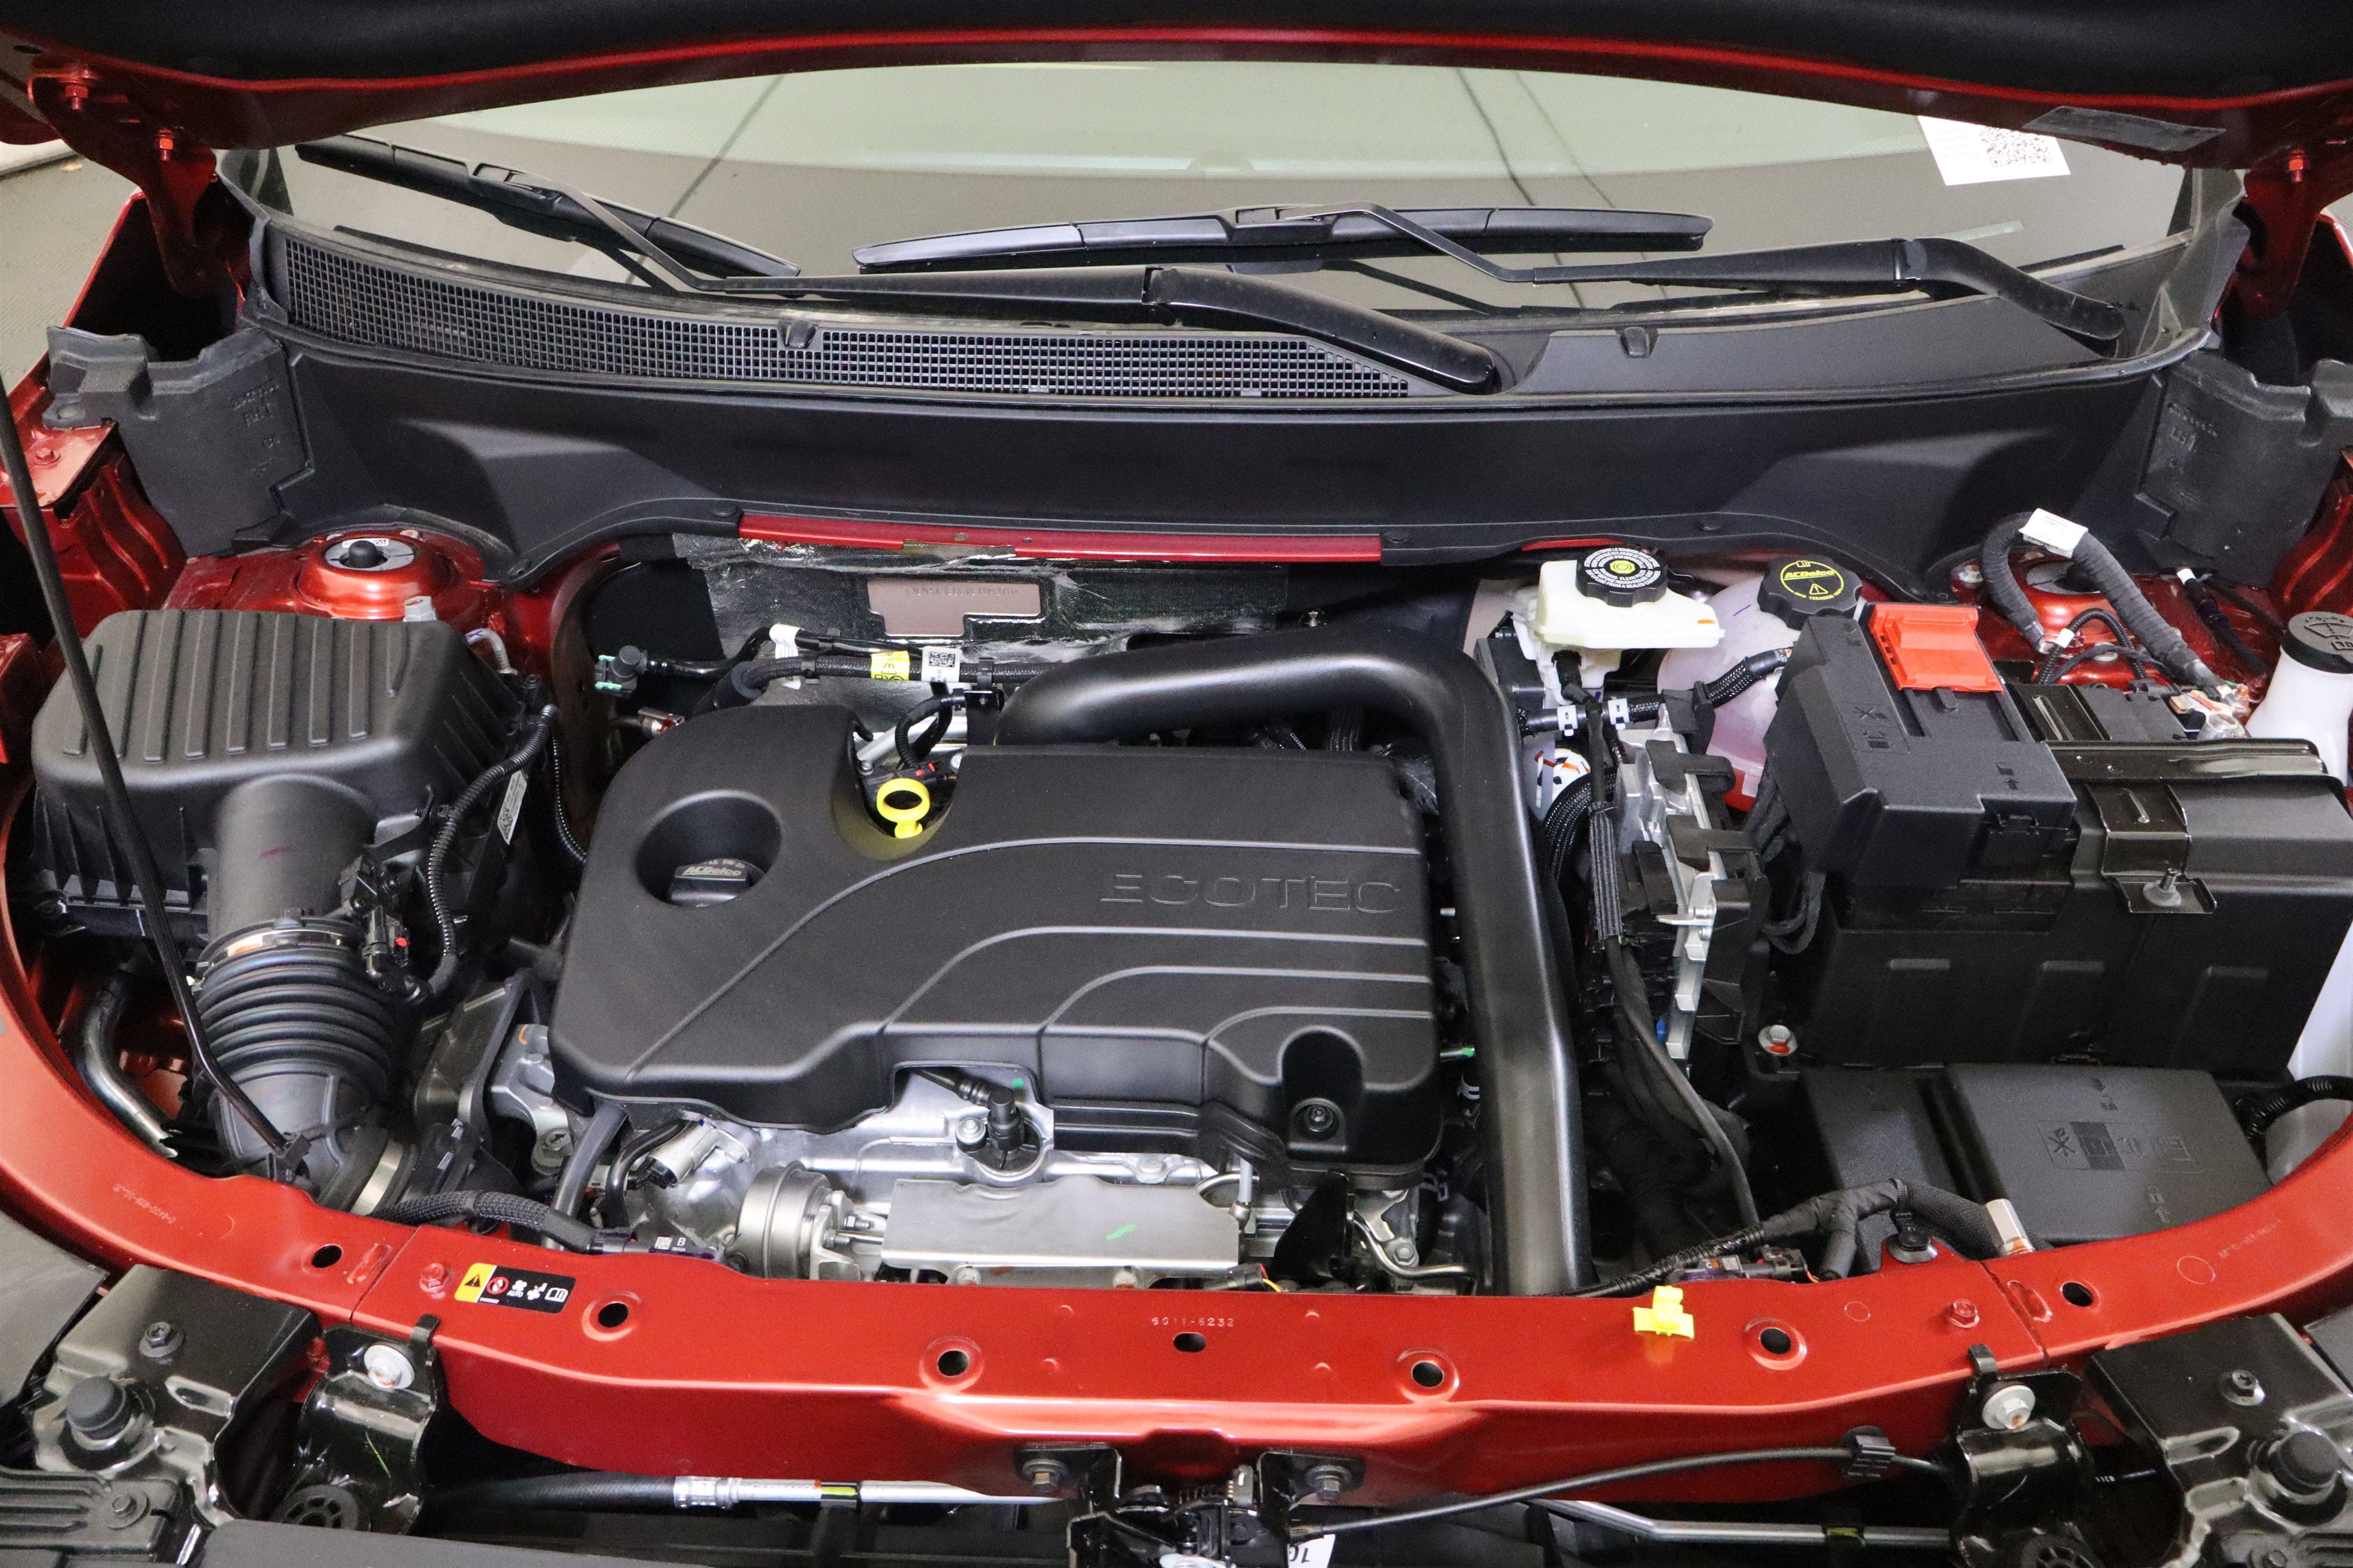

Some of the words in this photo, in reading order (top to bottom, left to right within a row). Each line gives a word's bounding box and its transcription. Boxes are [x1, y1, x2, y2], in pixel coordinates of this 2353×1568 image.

[1784, 570, 1835, 578] ACDelco
[682, 866, 742, 876] ACDelco
[1100, 874, 1402, 914] ECOTEC
[677, 1237, 686, 1246] B
[507, 1290, 524, 1298] AUTO
